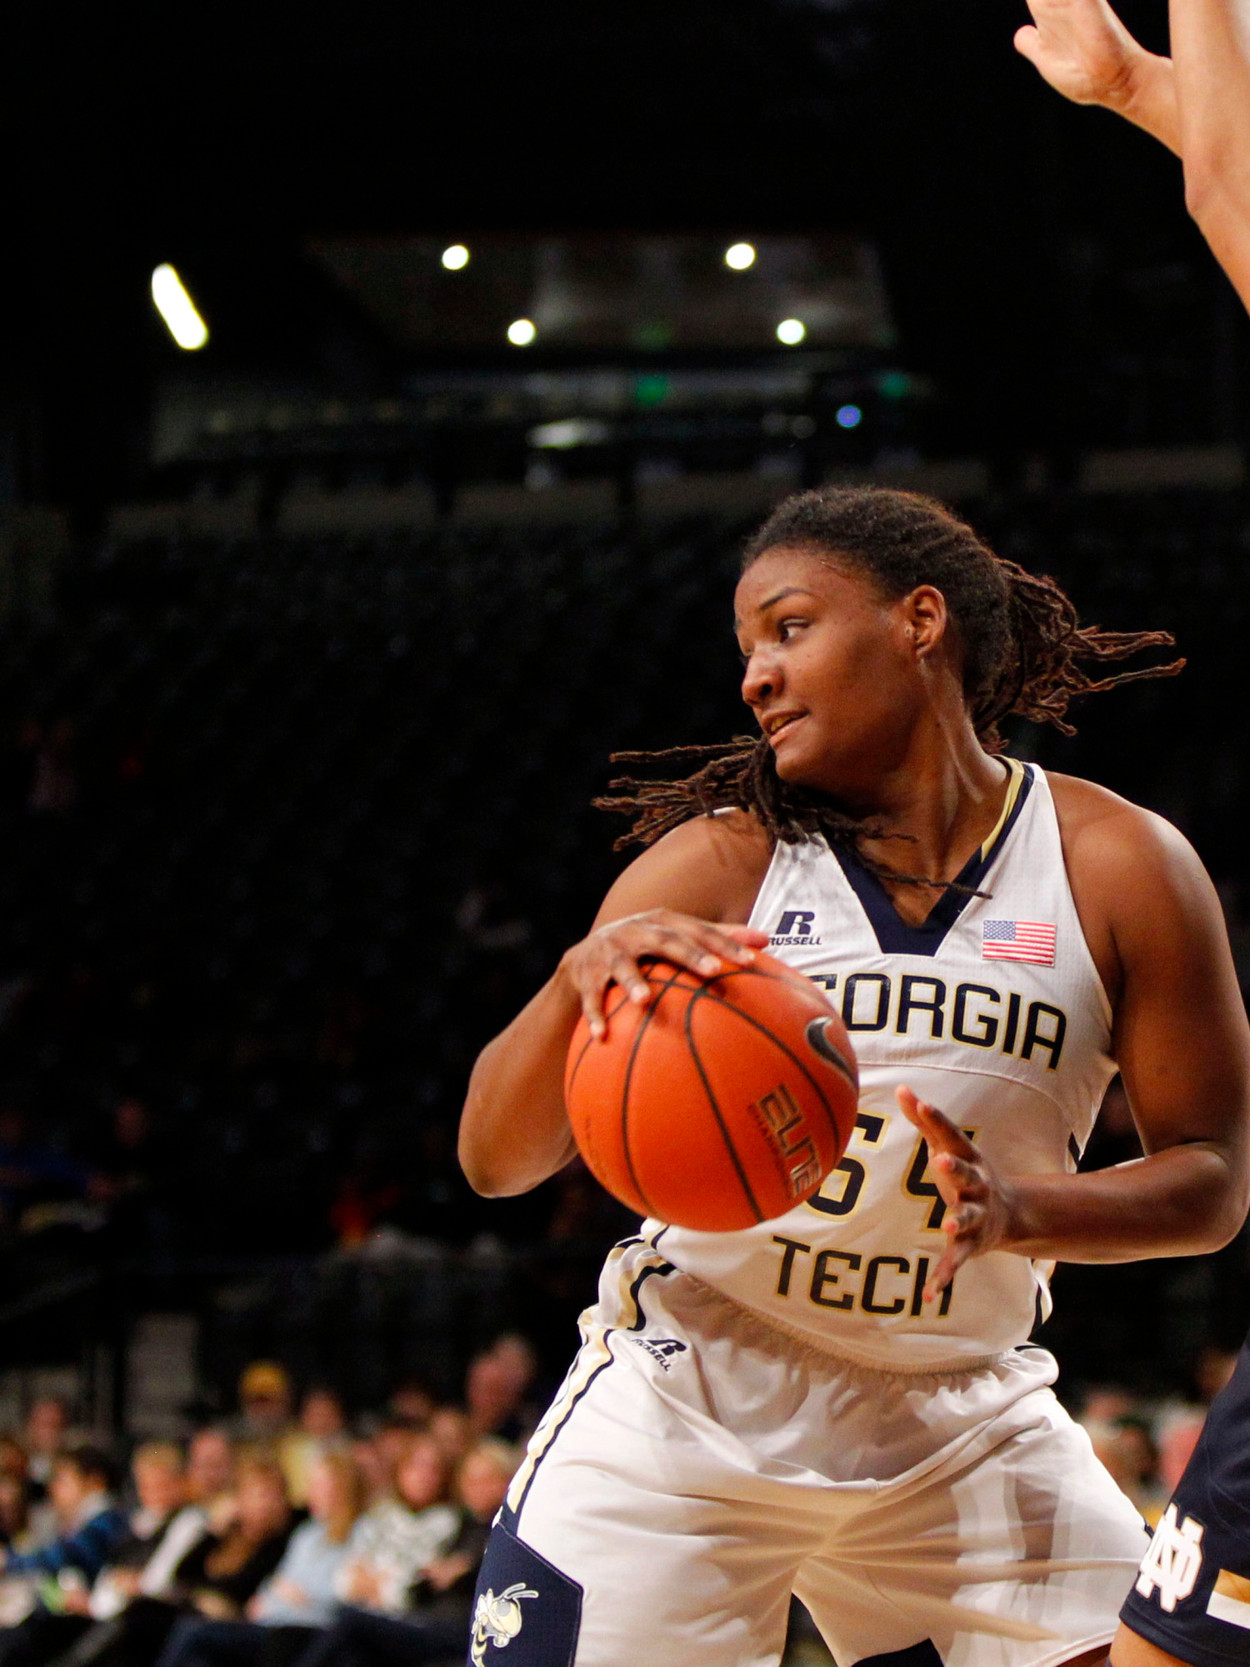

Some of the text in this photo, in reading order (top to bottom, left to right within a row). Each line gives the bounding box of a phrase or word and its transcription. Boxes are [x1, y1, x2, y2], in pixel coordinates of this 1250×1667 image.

[775, 911, 816, 935] R
[807, 971, 1068, 1074] ORGIA
[758, 1083, 822, 1197] ELITE
[772, 1234, 955, 1319] TECH
